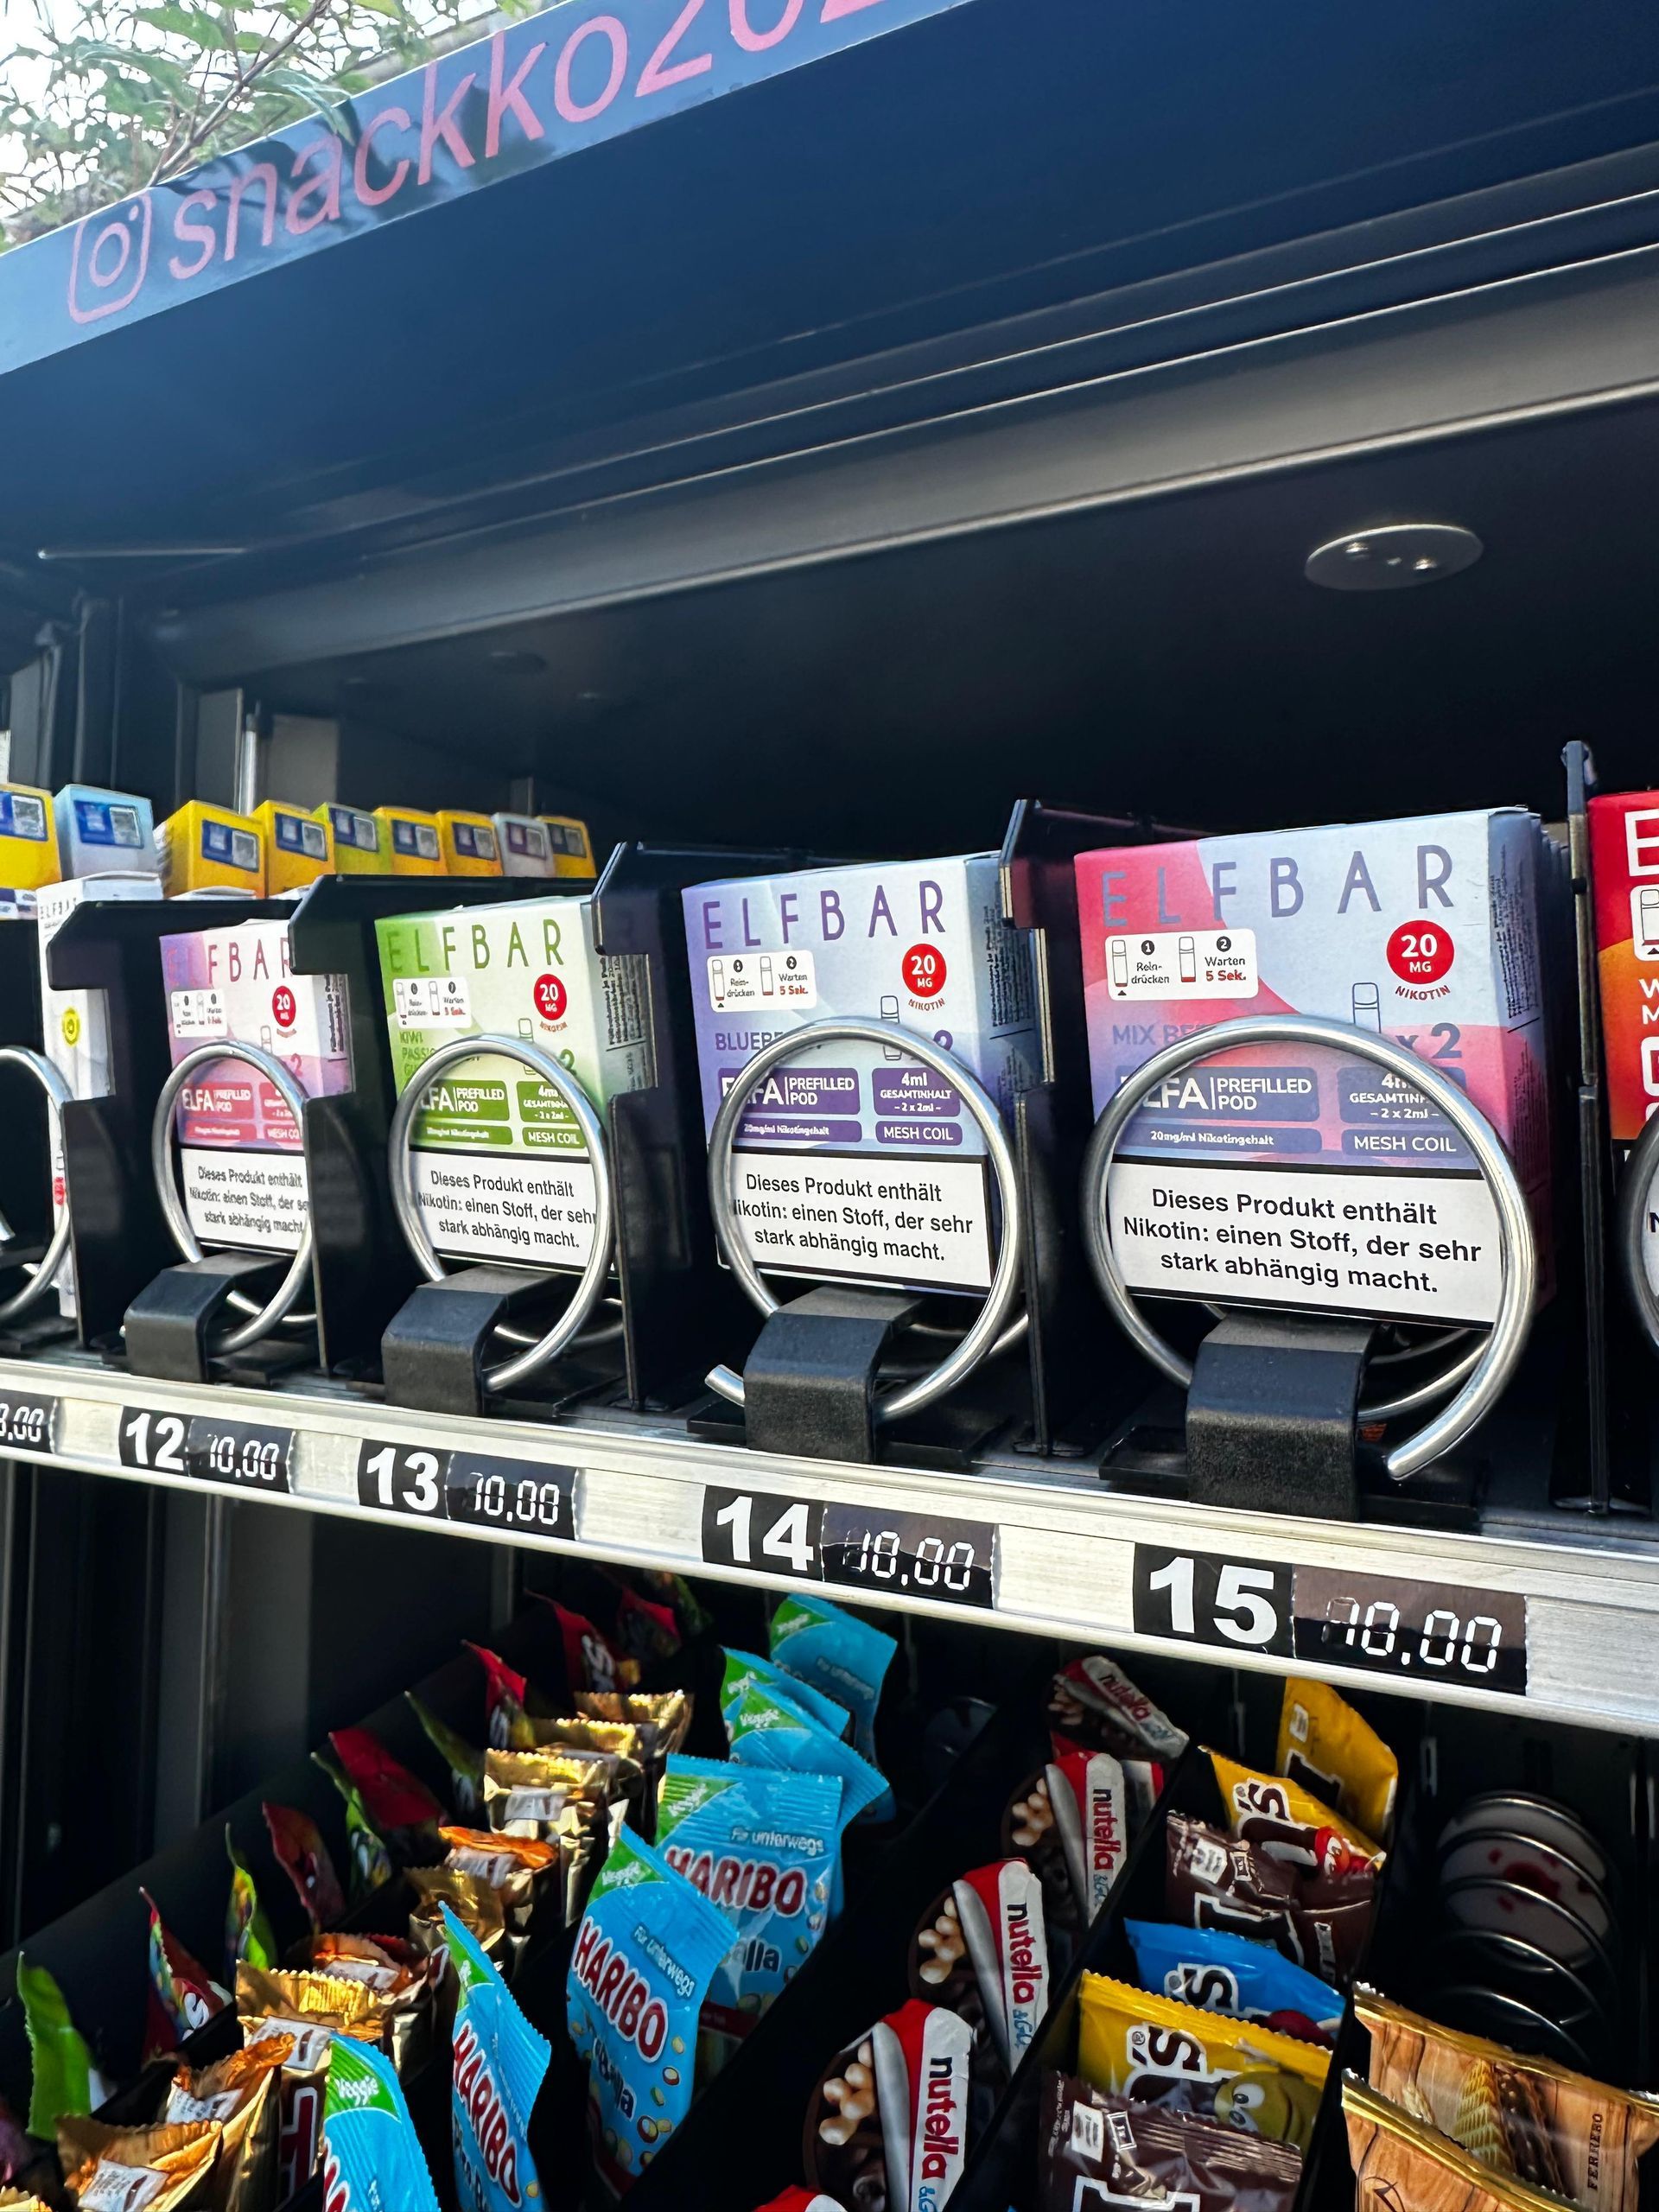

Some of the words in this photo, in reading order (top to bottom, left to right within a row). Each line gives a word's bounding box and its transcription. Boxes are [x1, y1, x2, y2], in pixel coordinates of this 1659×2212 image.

[1102, 844, 1455, 928] ELFBAR
[702, 880, 946, 950] ELFBAR
[386, 918, 564, 974] ELFBAR
[1401, 934, 1438, 958] 20
[911, 955, 936, 976] 20
[1205, 957, 1246, 967] Warten
[1205, 970, 1214, 982] 5
[1217, 969, 1247, 982] Sek.
[1408, 960, 1433, 974] MG
[539, 983, 560, 1002] 20
[917, 977, 932, 988] MG
[1131, 974, 1170, 985] drücken
[1394, 984, 1452, 1001] NIKOTIN
[1113, 1022, 1156, 1046] MIX
[1431, 1022, 1462, 1059] 2
[789, 1077, 855, 1091] PREFILLED
[901, 1071, 928, 1086] 4ml
[1217, 1077, 1313, 1094] PREFILLED
[457, 1100, 479, 1112] POD
[790, 1092, 818, 1105] POD
[1217, 1095, 1258, 1110] POD
[1381, 1108, 1389, 1119] 2
[1403, 1108, 1428, 1120] 2ml
[528, 1131, 555, 1143] MESH
[557, 1133, 580, 1145] COIL
[883, 1126, 919, 1140] MESH
[922, 1127, 953, 1141] COIL
[1150, 1130, 1196, 1143] 20mg/ml
[1198, 1133, 1274, 1146] Nikotingehalt
[1354, 1135, 1407, 1151] MESH
[1411, 1136, 1457, 1152] COIL
[430, 1170, 471, 1189] Dieses
[474, 1173, 524, 1193] Produkt
[527, 1179, 575, 1198] enthält
[746, 1173, 800, 1194] Dieses
[804, 1176, 873, 1198] Produkt
[878, 1182, 942, 1203] enthält
[465, 1198, 499, 1215] einen
[502, 1200, 538, 1222] Stoff,
[542, 1205, 563, 1222] der
[792, 1205, 838, 1224] einen
[842, 1207, 890, 1231] Stoff,
[894, 1211, 925, 1231] der
[931, 1214, 974, 1234] sehr
[1152, 1188, 1230, 1212] Dieses
[1236, 1193, 1336, 1221] Produkt
[1343, 1199, 1438, 1226] enthält
[439, 1219, 469, 1236] stark
[472, 1223, 531, 1246] abhängig
[534, 1230, 580, 1249] macht.
[754, 1228, 795, 1248] stark
[798, 1232, 878, 1258] abhängig
[883, 1241, 945, 1262] macht.
[1123, 1216, 1210, 1243] Nikotin:
[1216, 1227, 1282, 1249] einen
[1289, 1229, 1358, 1258] Stoff,
[1366, 1235, 1410, 1259] der
[1418, 1240, 1483, 1263] sehr
[1160, 1250, 1219, 1273] stark
[1224, 1256, 1339, 1289] abhängig
[1348, 1268, 1438, 1294] macht.
[126, 1413, 185, 1471] 12
[209, 1434, 280, 1481] 10.00
[366, 1447, 439, 1511] 13
[470, 1472, 560, 1526] 10.00
[716, 1495, 814, 1572] 14
[859, 1529, 976, 1592] 10.00
[1148, 1556, 1277, 1644] 15
[1344, 1599, 1503, 1674] 10.00
[1092, 1787, 1122, 1872] nutella
[1007, 1903, 1045, 2005] nutella
[569, 1916, 669, 2063] HARIBO
[923, 2056, 960, 2182] nutella
